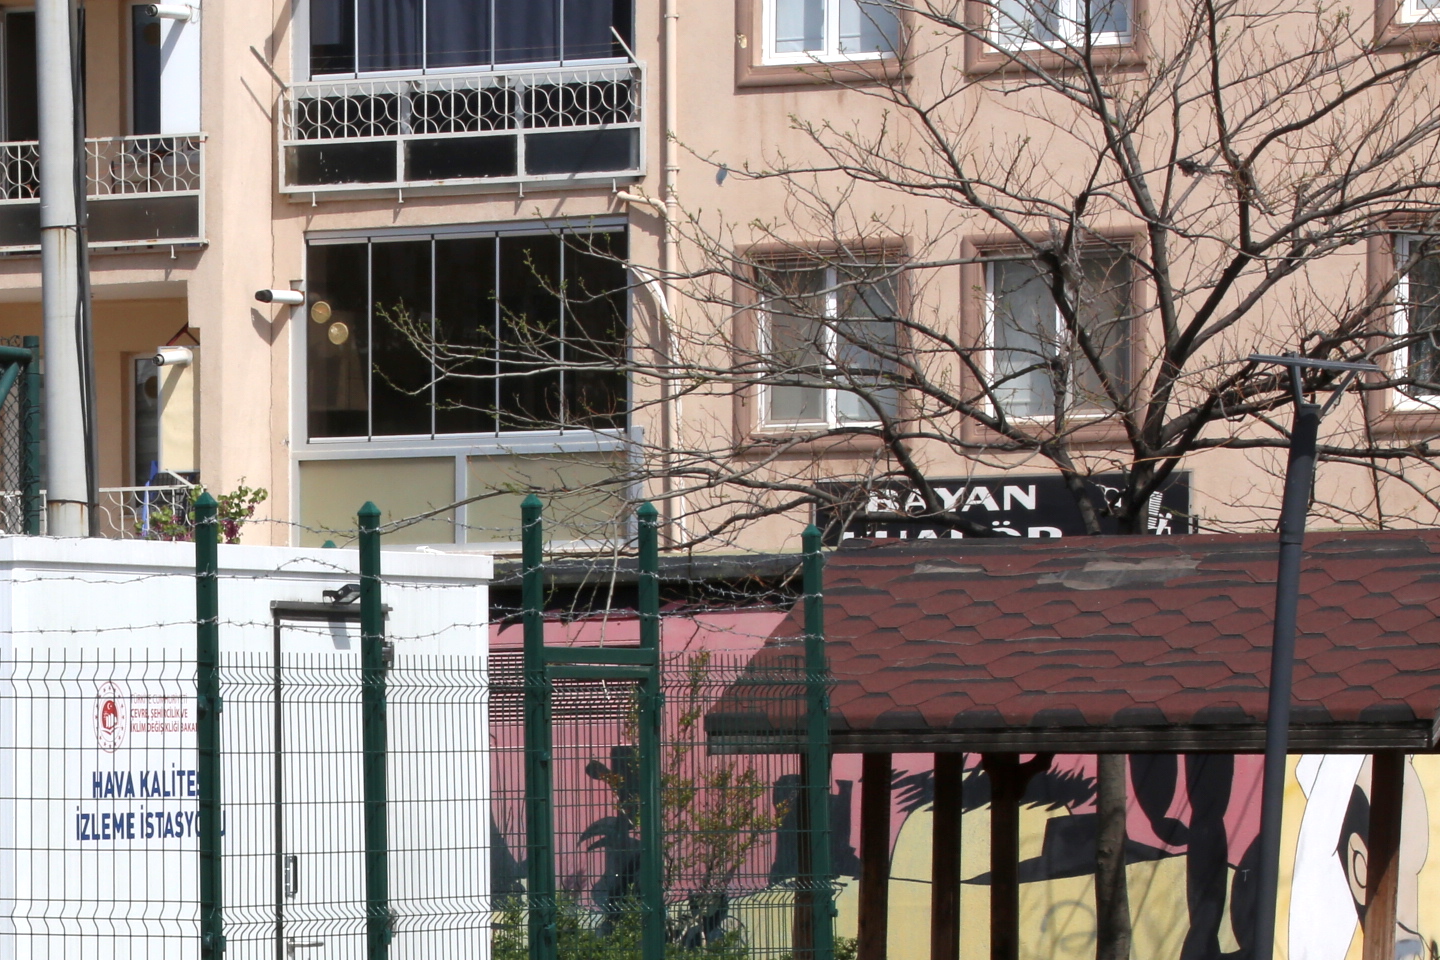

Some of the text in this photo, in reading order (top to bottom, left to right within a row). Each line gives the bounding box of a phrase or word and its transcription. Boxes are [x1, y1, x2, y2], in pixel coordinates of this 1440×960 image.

[868, 485, 1036, 513] BAYAN
[92, 762, 200, 798] HAVA KALİTE
[76, 806, 135, 841] İZLEME
